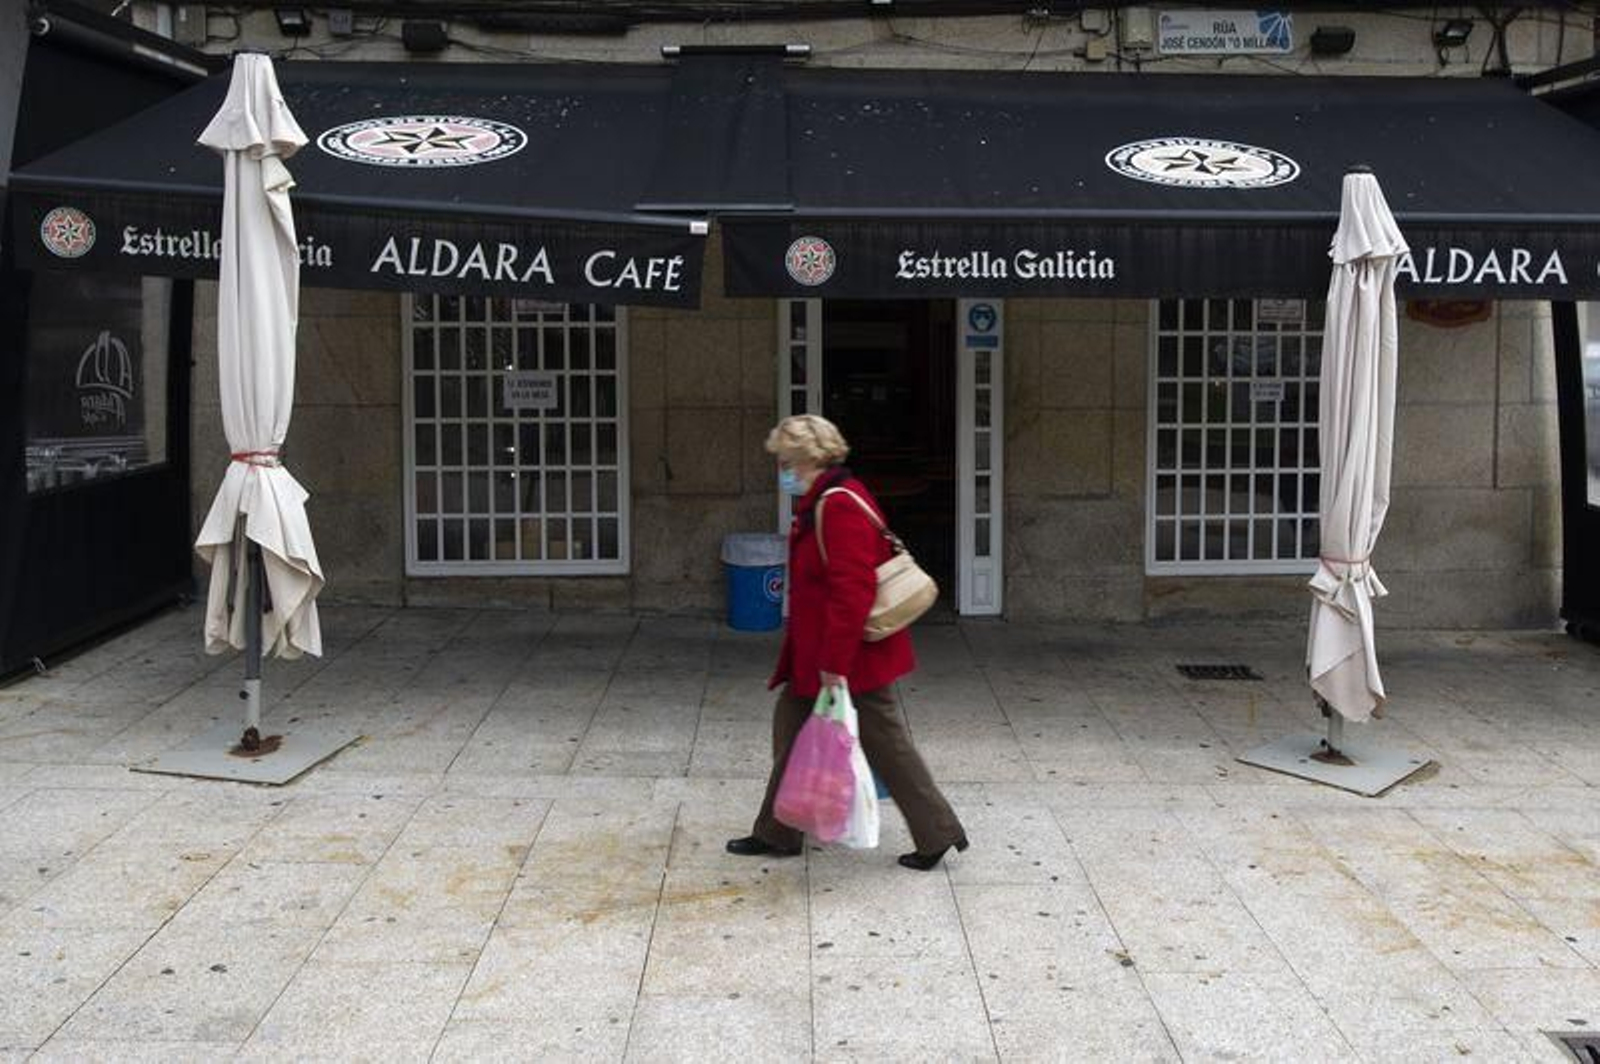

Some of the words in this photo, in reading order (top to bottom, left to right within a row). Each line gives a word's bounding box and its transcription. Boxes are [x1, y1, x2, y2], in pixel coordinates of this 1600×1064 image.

[1161, 36, 1184, 49] JOSÉ
[371, 236, 554, 284] ALDARA
[584, 250, 685, 291] CAFÉ
[895, 249, 1006, 279] Estrella
[1014, 249, 1115, 279] Galicia
[1395, 248, 1568, 284] ALDARA
